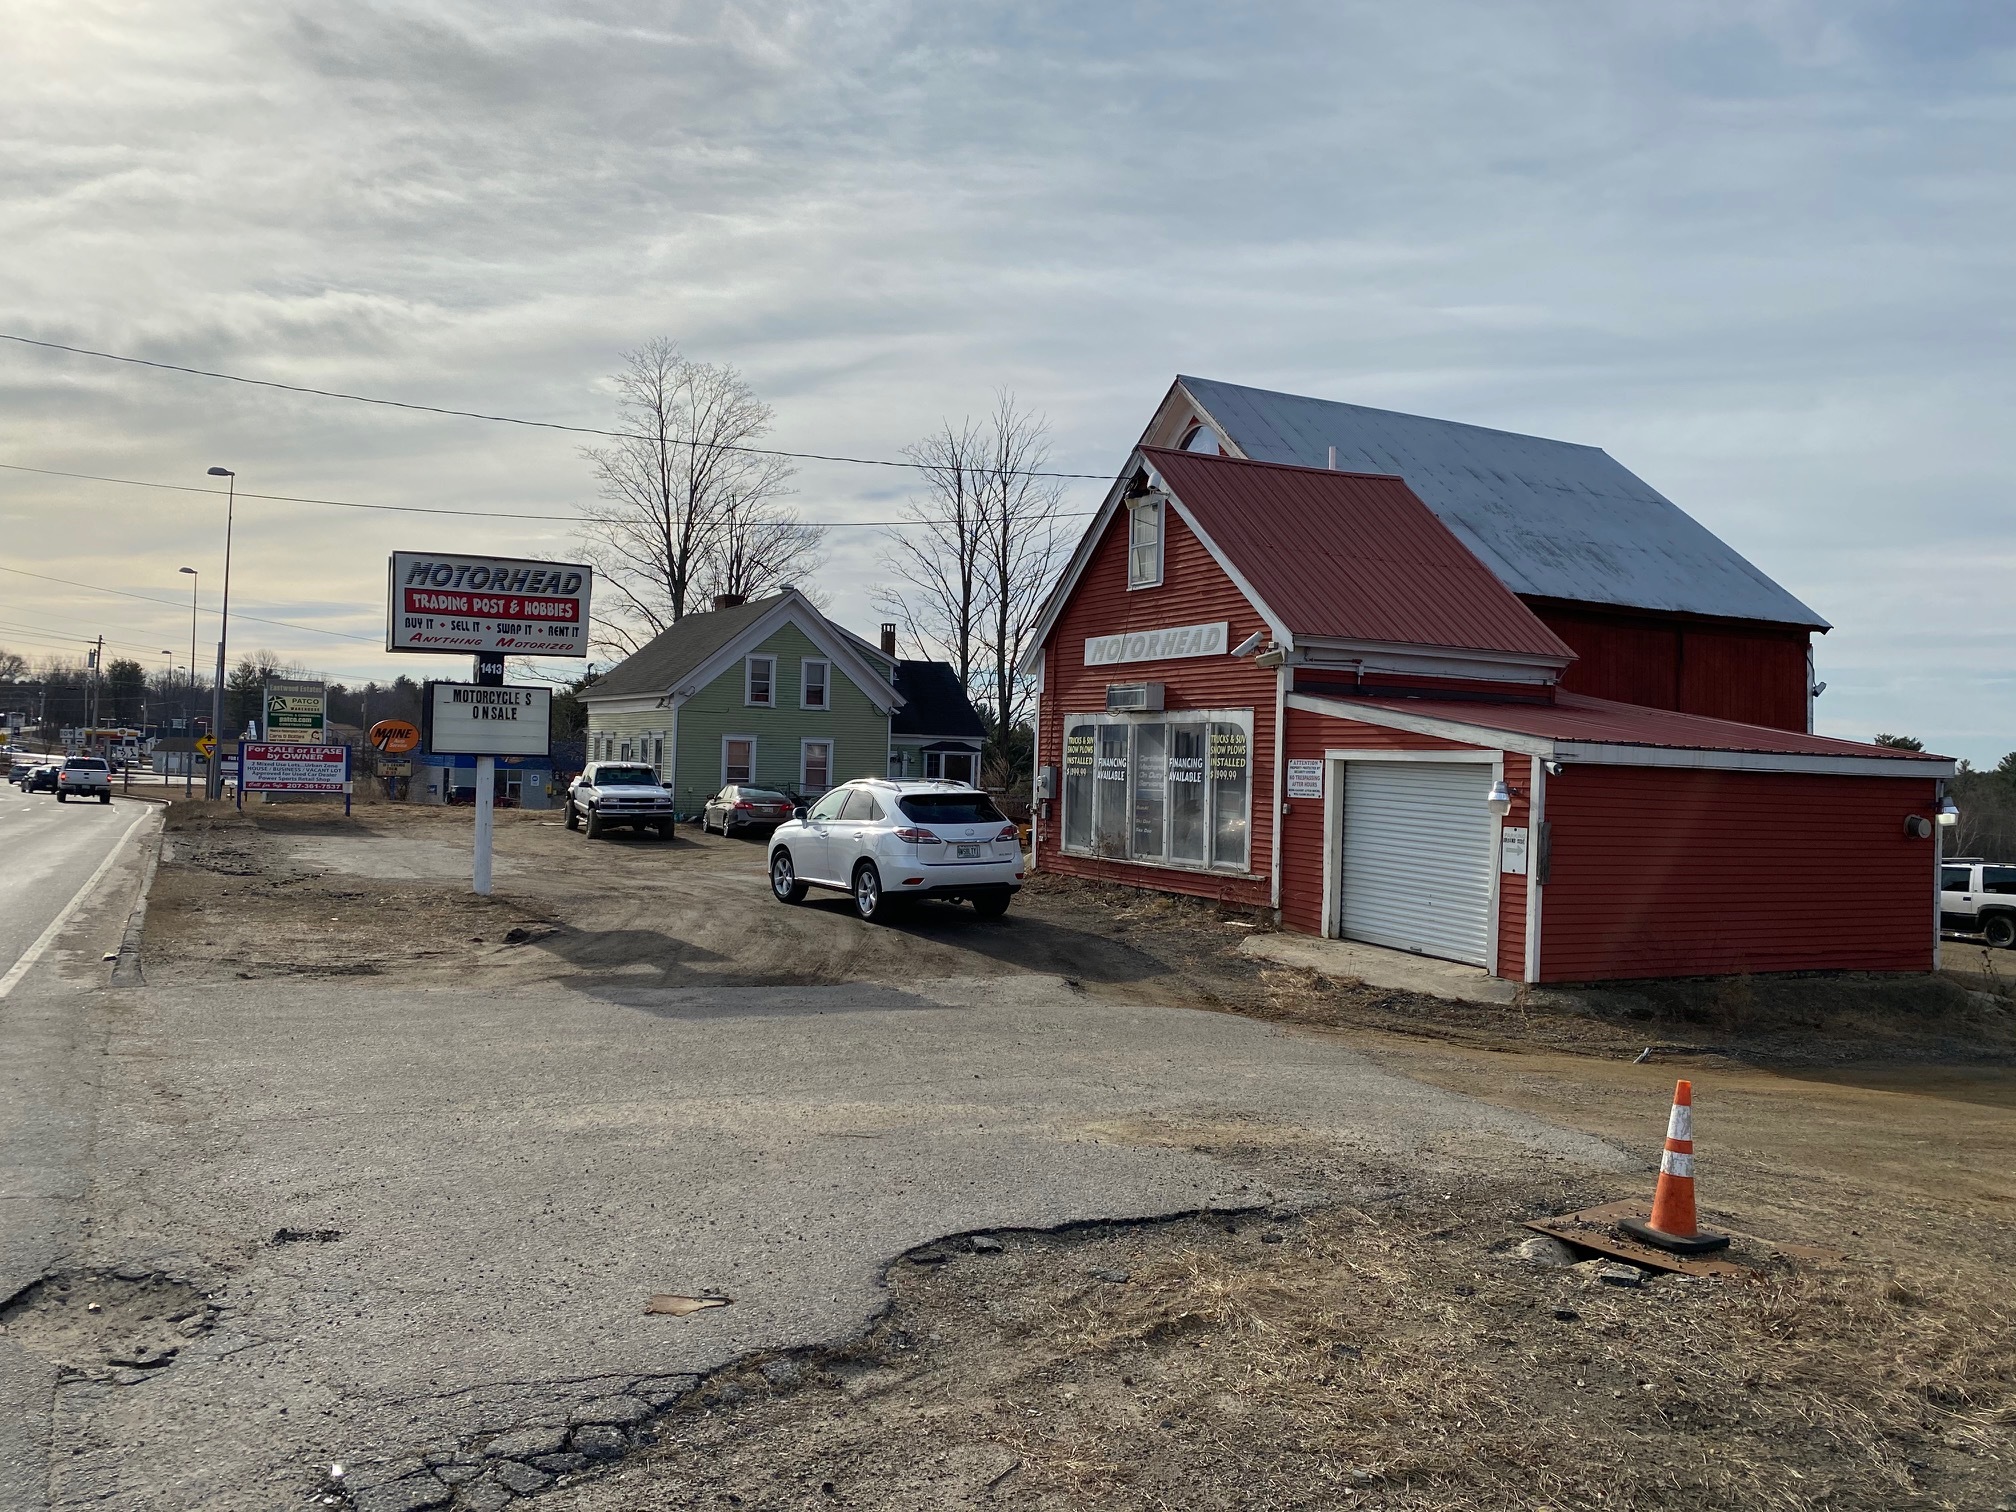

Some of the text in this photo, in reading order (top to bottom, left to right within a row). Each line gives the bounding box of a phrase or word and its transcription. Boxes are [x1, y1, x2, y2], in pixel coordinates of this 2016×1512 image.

[405, 562, 582, 595] MOTORHEAD
[413, 593, 572, 617] TRADING POST & HOBBIES
[405, 617, 579, 638] BUY IT SELL IT SWAP IT RENT IT
[1091, 627, 1221, 662] MOTORHEAD
[481, 663, 502, 674] 1413
[473, 706, 517, 720] ON SALE
[374, 728, 413, 738] MAINE
[1210, 734, 1246, 744] TRUCKS & SUV
[1079, 746, 1093, 754] PLOWS
[1210, 745, 1246, 755] SNOW PLOWS
[1066, 756, 1093, 765] INSTALLED
[1098, 758, 1126, 767] FINANCING
[1169, 758, 1202, 768] FINANCING
[1210, 758, 1245, 767] INSTALLED
[1097, 770, 1125, 781] AVAILABLE
[1169, 772, 1201, 782] AVAILABLE
